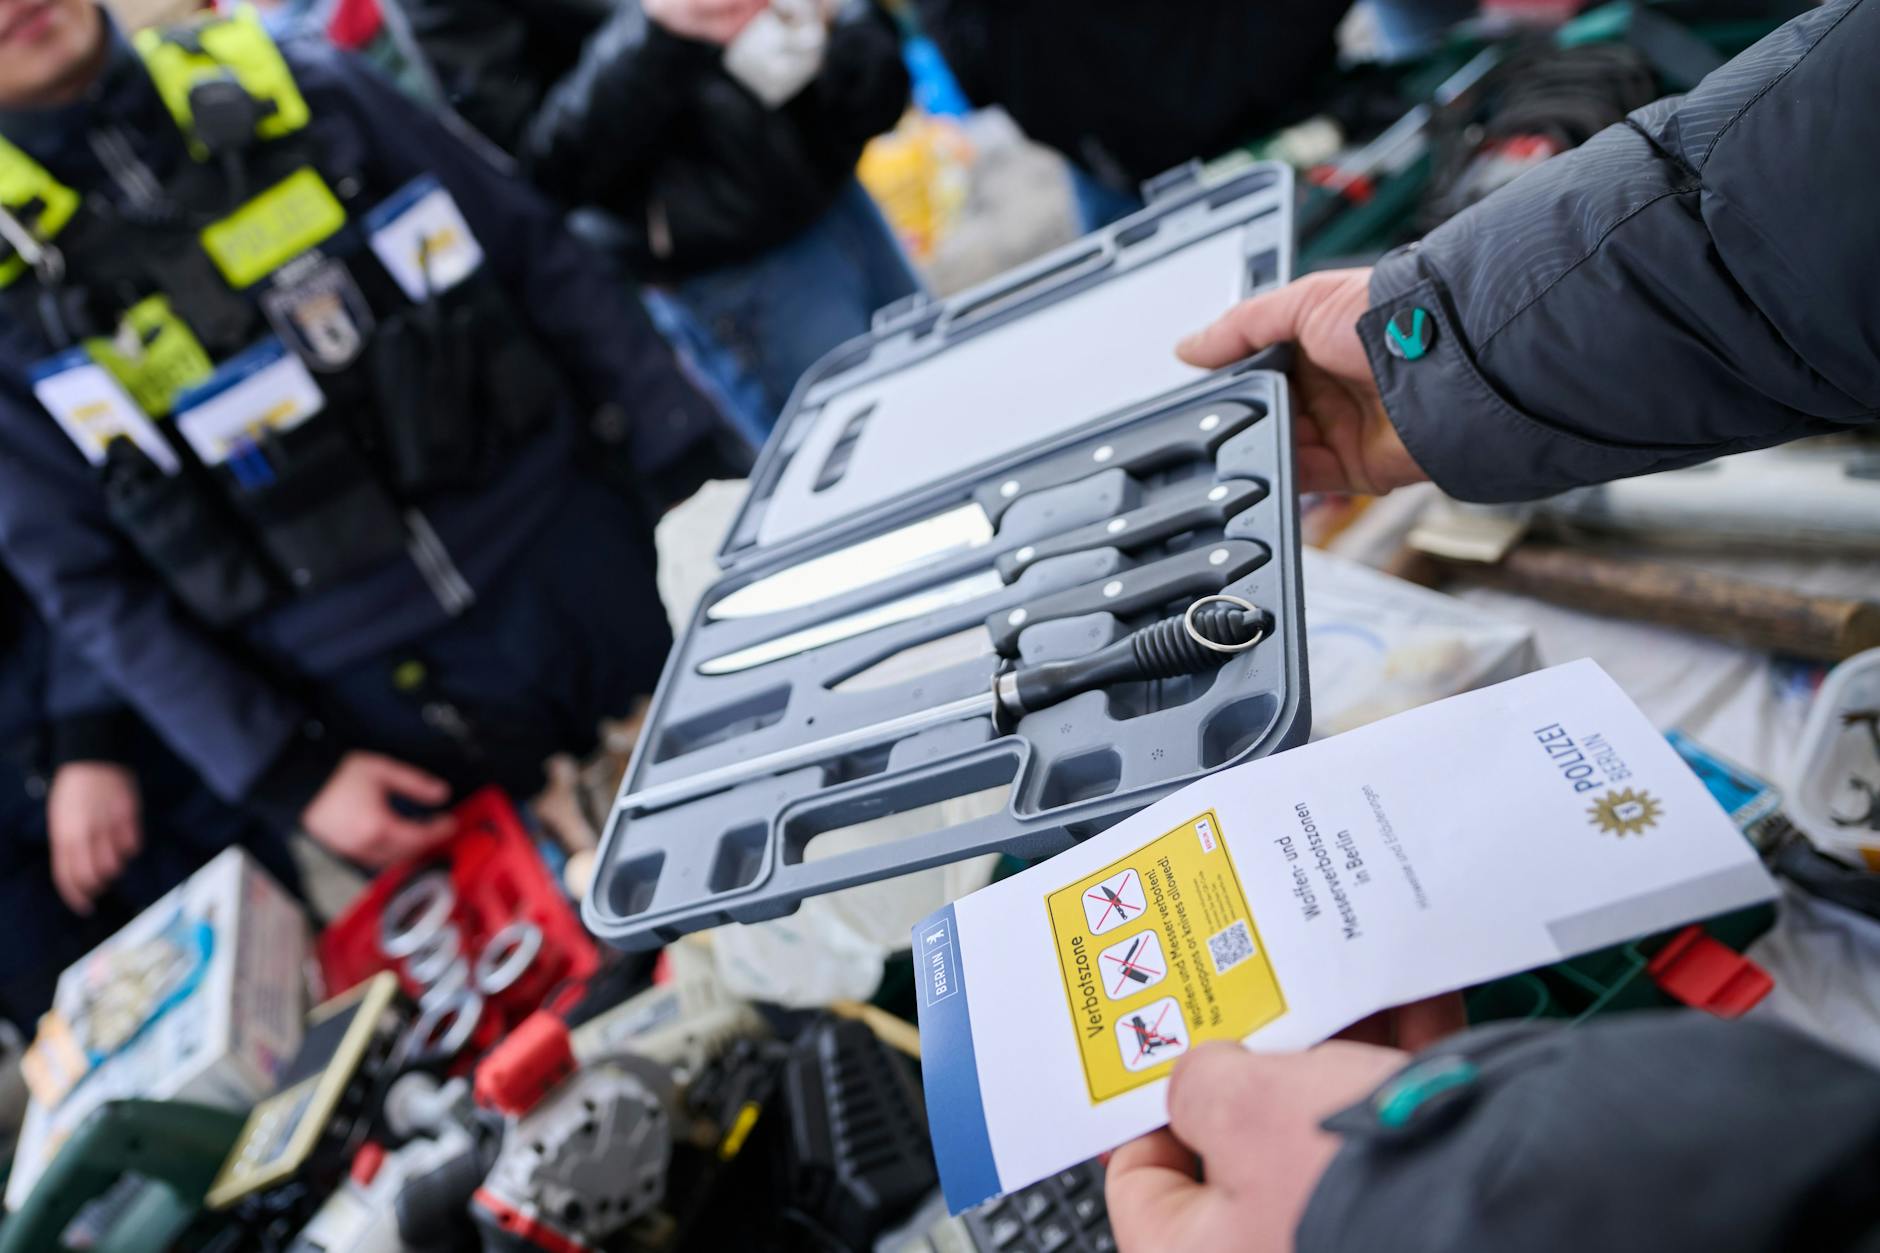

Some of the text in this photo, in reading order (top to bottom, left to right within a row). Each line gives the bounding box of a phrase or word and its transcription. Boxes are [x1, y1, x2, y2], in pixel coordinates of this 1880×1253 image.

[1533, 722, 1604, 792] POLIZEI
[1580, 733, 1632, 782] BERLIN
[1157, 856, 1181, 901] allowed!
[1274, 835, 1321, 922] Waffen- und
[1294, 802, 1363, 941] Messerverbotszonen
[1335, 829, 1371, 886] in Berlin
[1175, 901, 1192, 938] knives
[1186, 937, 1197, 949] or
[931, 951, 948, 996] BERLIN
[1144, 868, 1204, 1029] Waffen und Messer verboten!
[1071, 935, 1104, 1039] Verbotszone
[1192, 950, 1215, 1004] weapons
[1210, 1005, 1223, 1027] No
